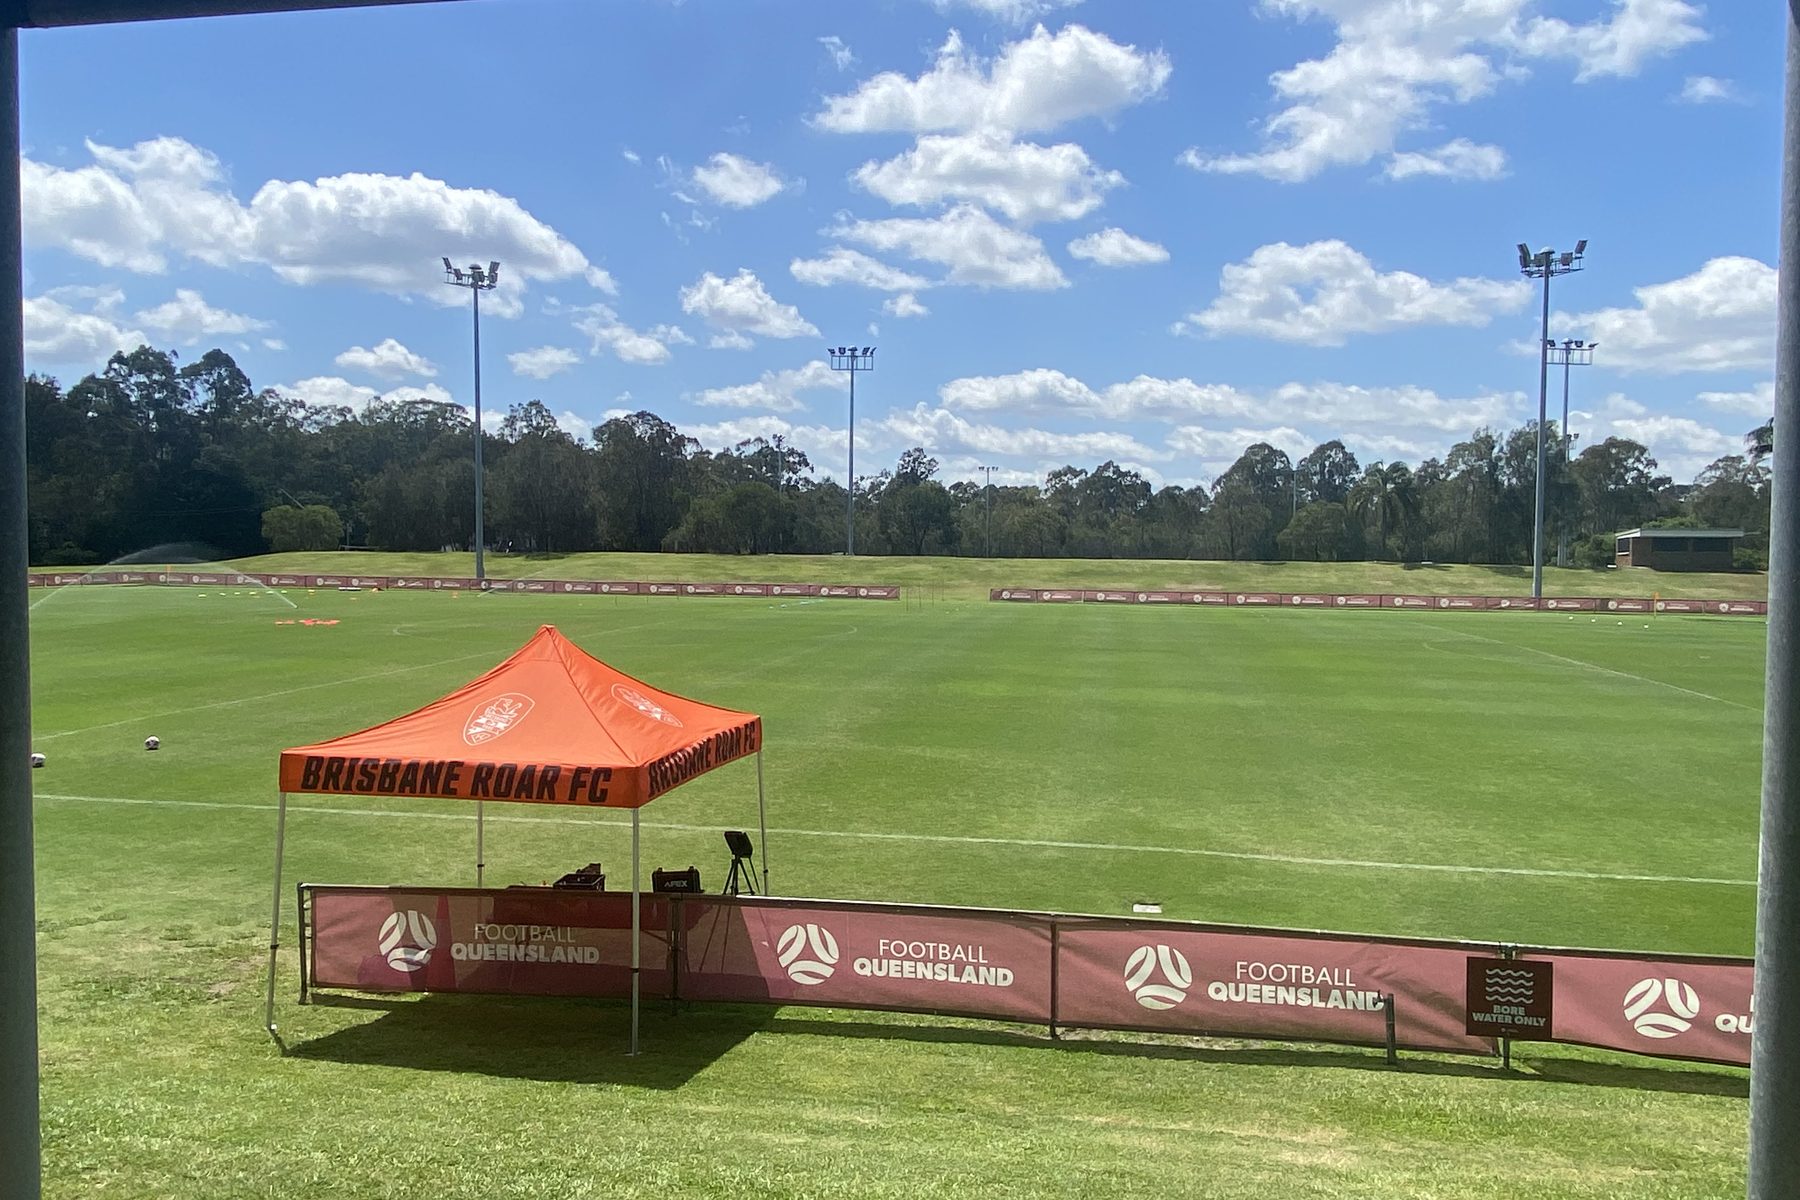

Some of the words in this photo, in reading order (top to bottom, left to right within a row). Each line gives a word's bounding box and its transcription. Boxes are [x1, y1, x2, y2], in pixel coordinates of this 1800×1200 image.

[743, 720, 756, 753] FC
[301, 755, 465, 796] BRISBANE
[470, 762, 562, 801] ROAR
[568, 766, 614, 803] FC
[474, 923, 577, 943] FOOTBALL
[450, 943, 600, 965] QUEENSLAND
[878, 939, 988, 964] FOOTBALL
[852, 958, 1014, 987] QUEENSLAND
[1236, 961, 1356, 987] FOOTBALL
[1207, 981, 1385, 1012] QUEENSLAND
[1472, 1011, 1512, 1024] WATER
[1514, 1015, 1546, 1027] ONLY
[1493, 1004, 1526, 1016] BORE
